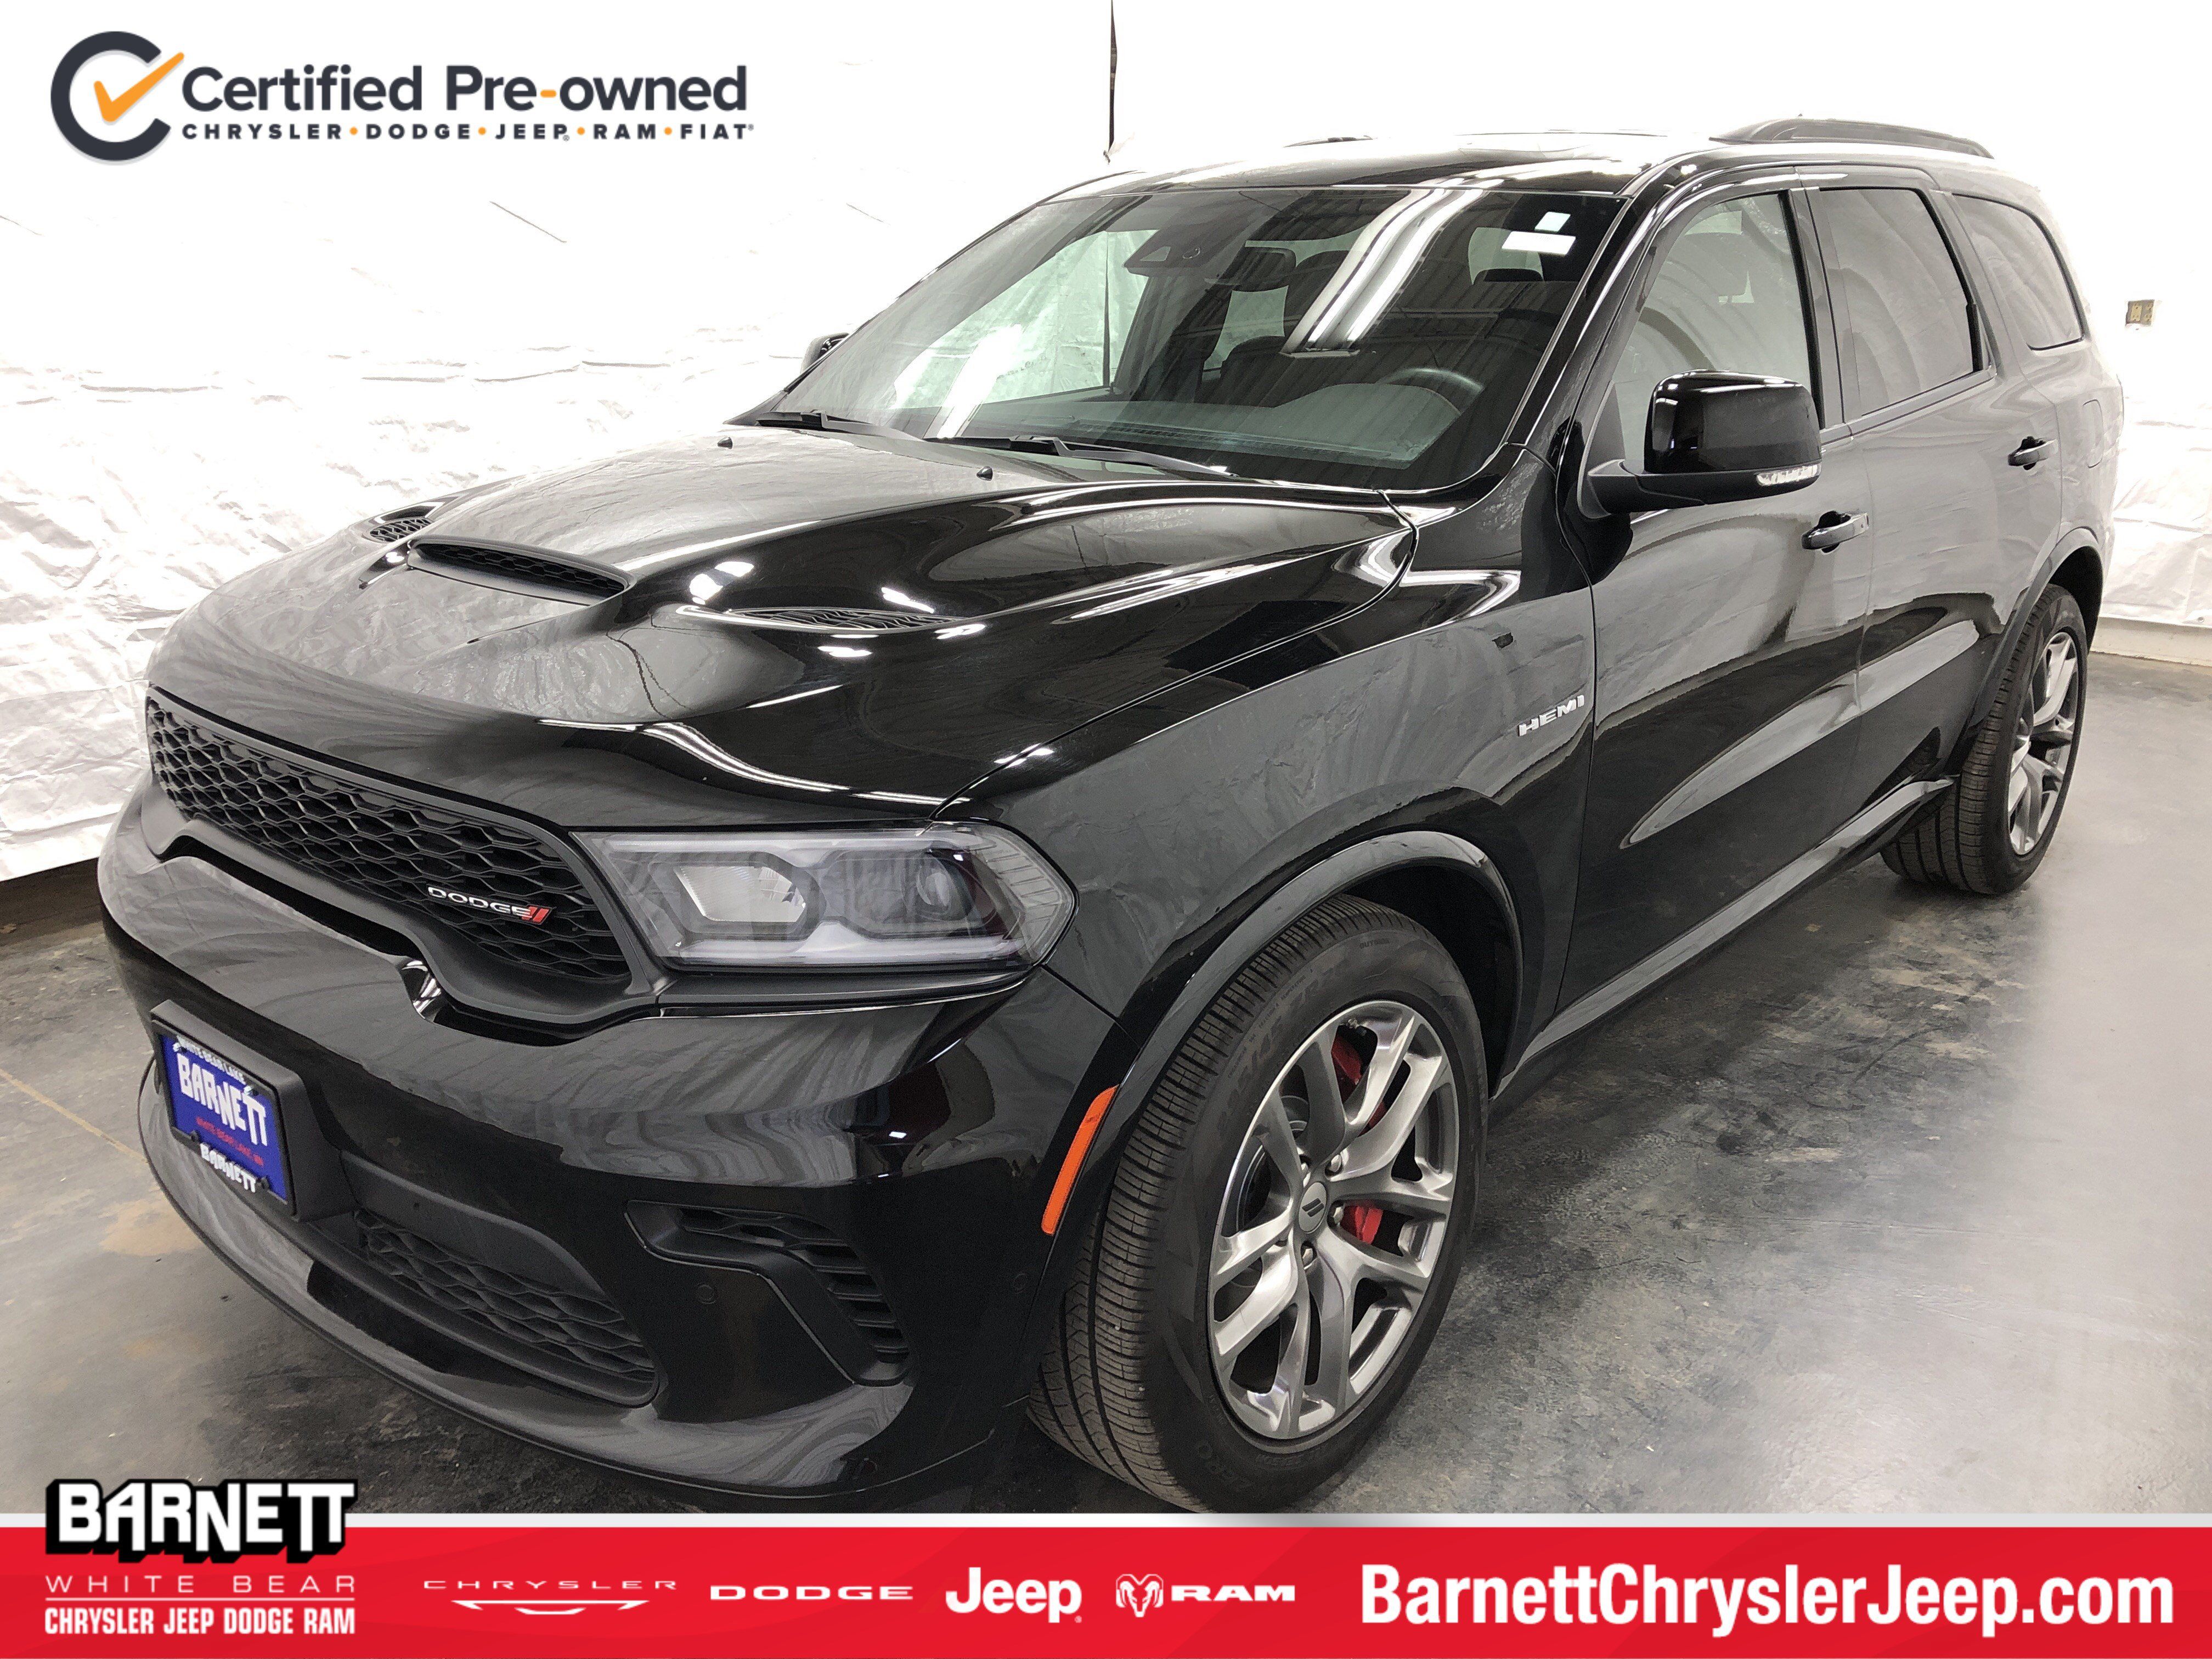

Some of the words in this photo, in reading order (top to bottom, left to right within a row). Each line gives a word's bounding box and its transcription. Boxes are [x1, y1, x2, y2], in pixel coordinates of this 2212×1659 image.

[1519, 695, 1584, 736] HEMI
[428, 886, 532, 919] DODGE
[177, 1053, 268, 1147] BARNETT
[200, 1143, 257, 1194] BARNETT
